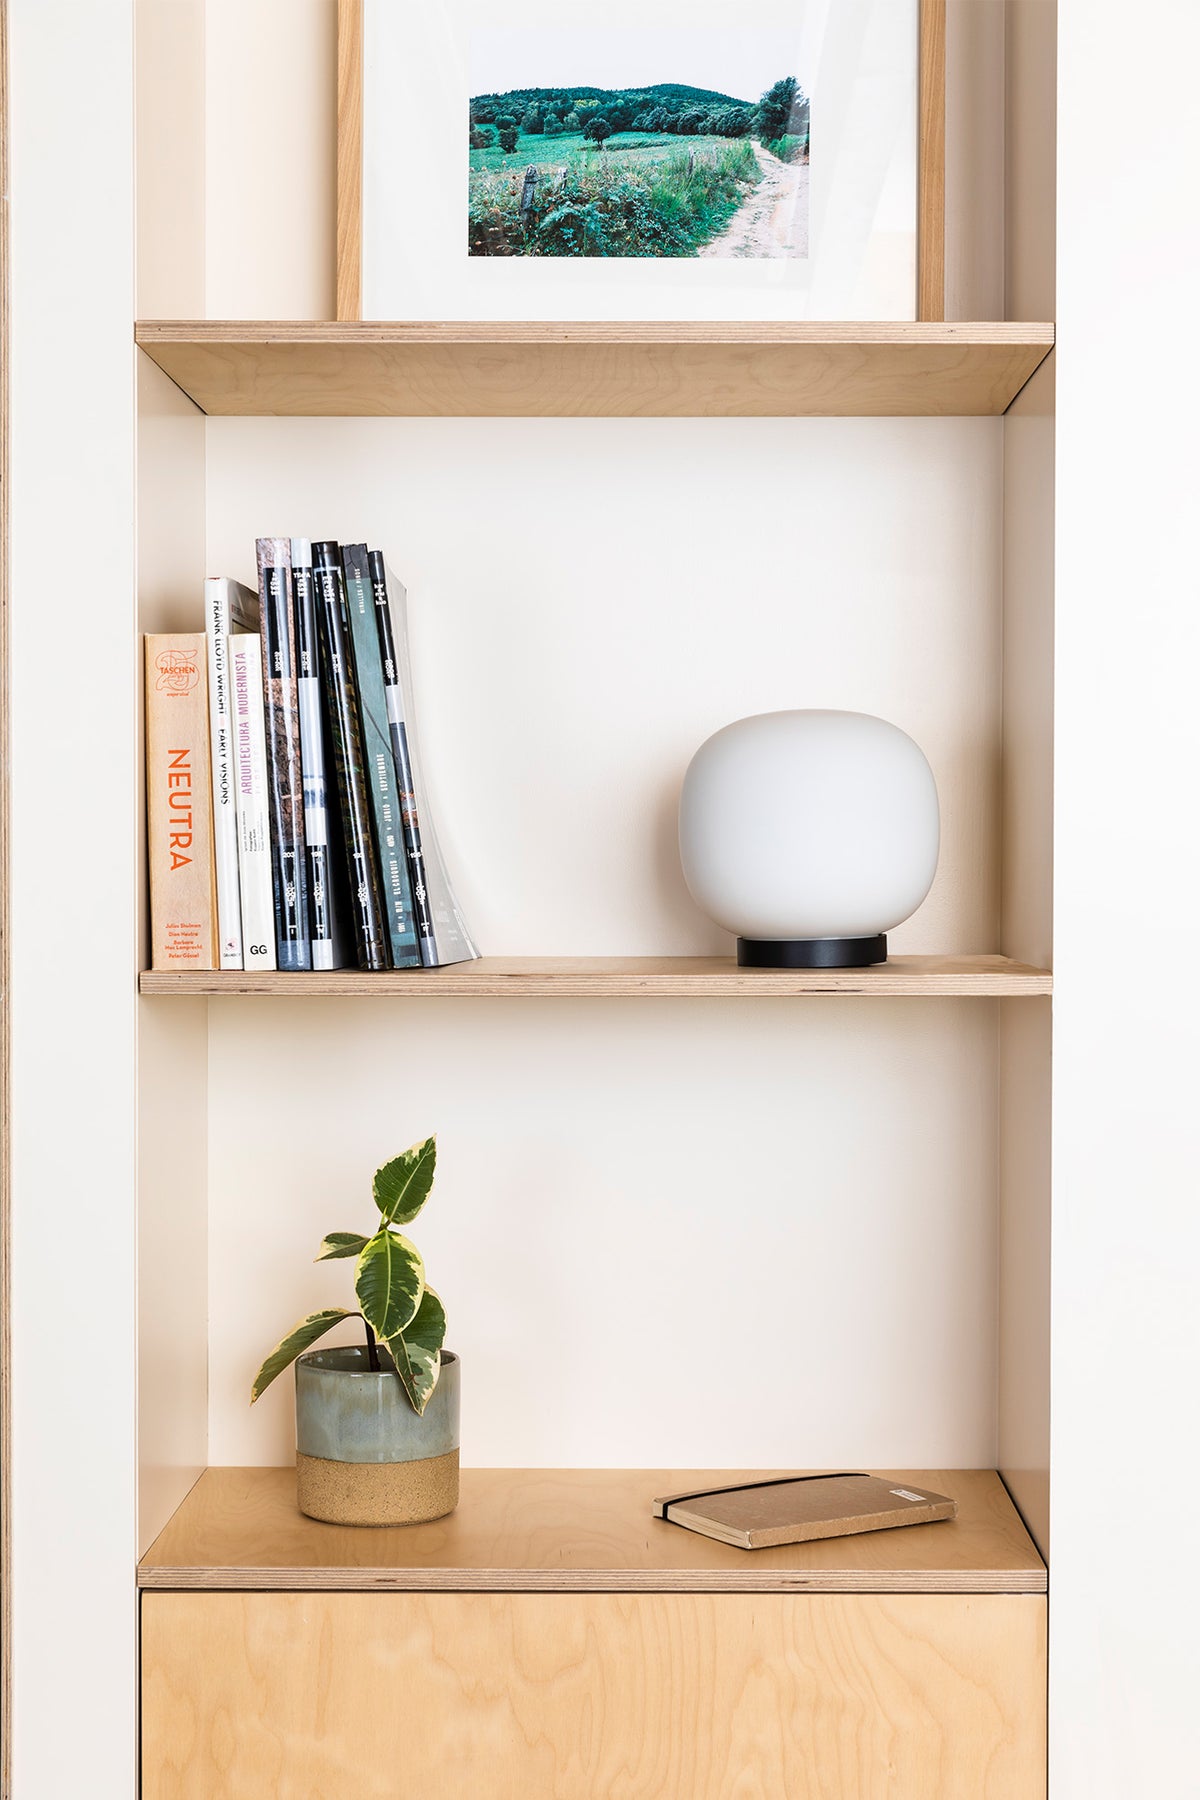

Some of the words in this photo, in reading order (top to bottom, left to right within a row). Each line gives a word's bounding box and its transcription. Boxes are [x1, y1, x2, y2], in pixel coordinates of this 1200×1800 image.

[213, 600, 224, 635] FRANK
[160, 666, 195, 674] TASCHEN
[215, 638, 226, 671] LLOYD
[217, 674, 227, 714] WRIGHT
[235, 652, 249, 716] MODERNISTA
[238, 721, 253, 795] ARQUITECTURA
[219, 763, 230, 805] VISIONS
[167, 749, 193, 871] NEUTRA
[250, 944, 268, 955] GG
